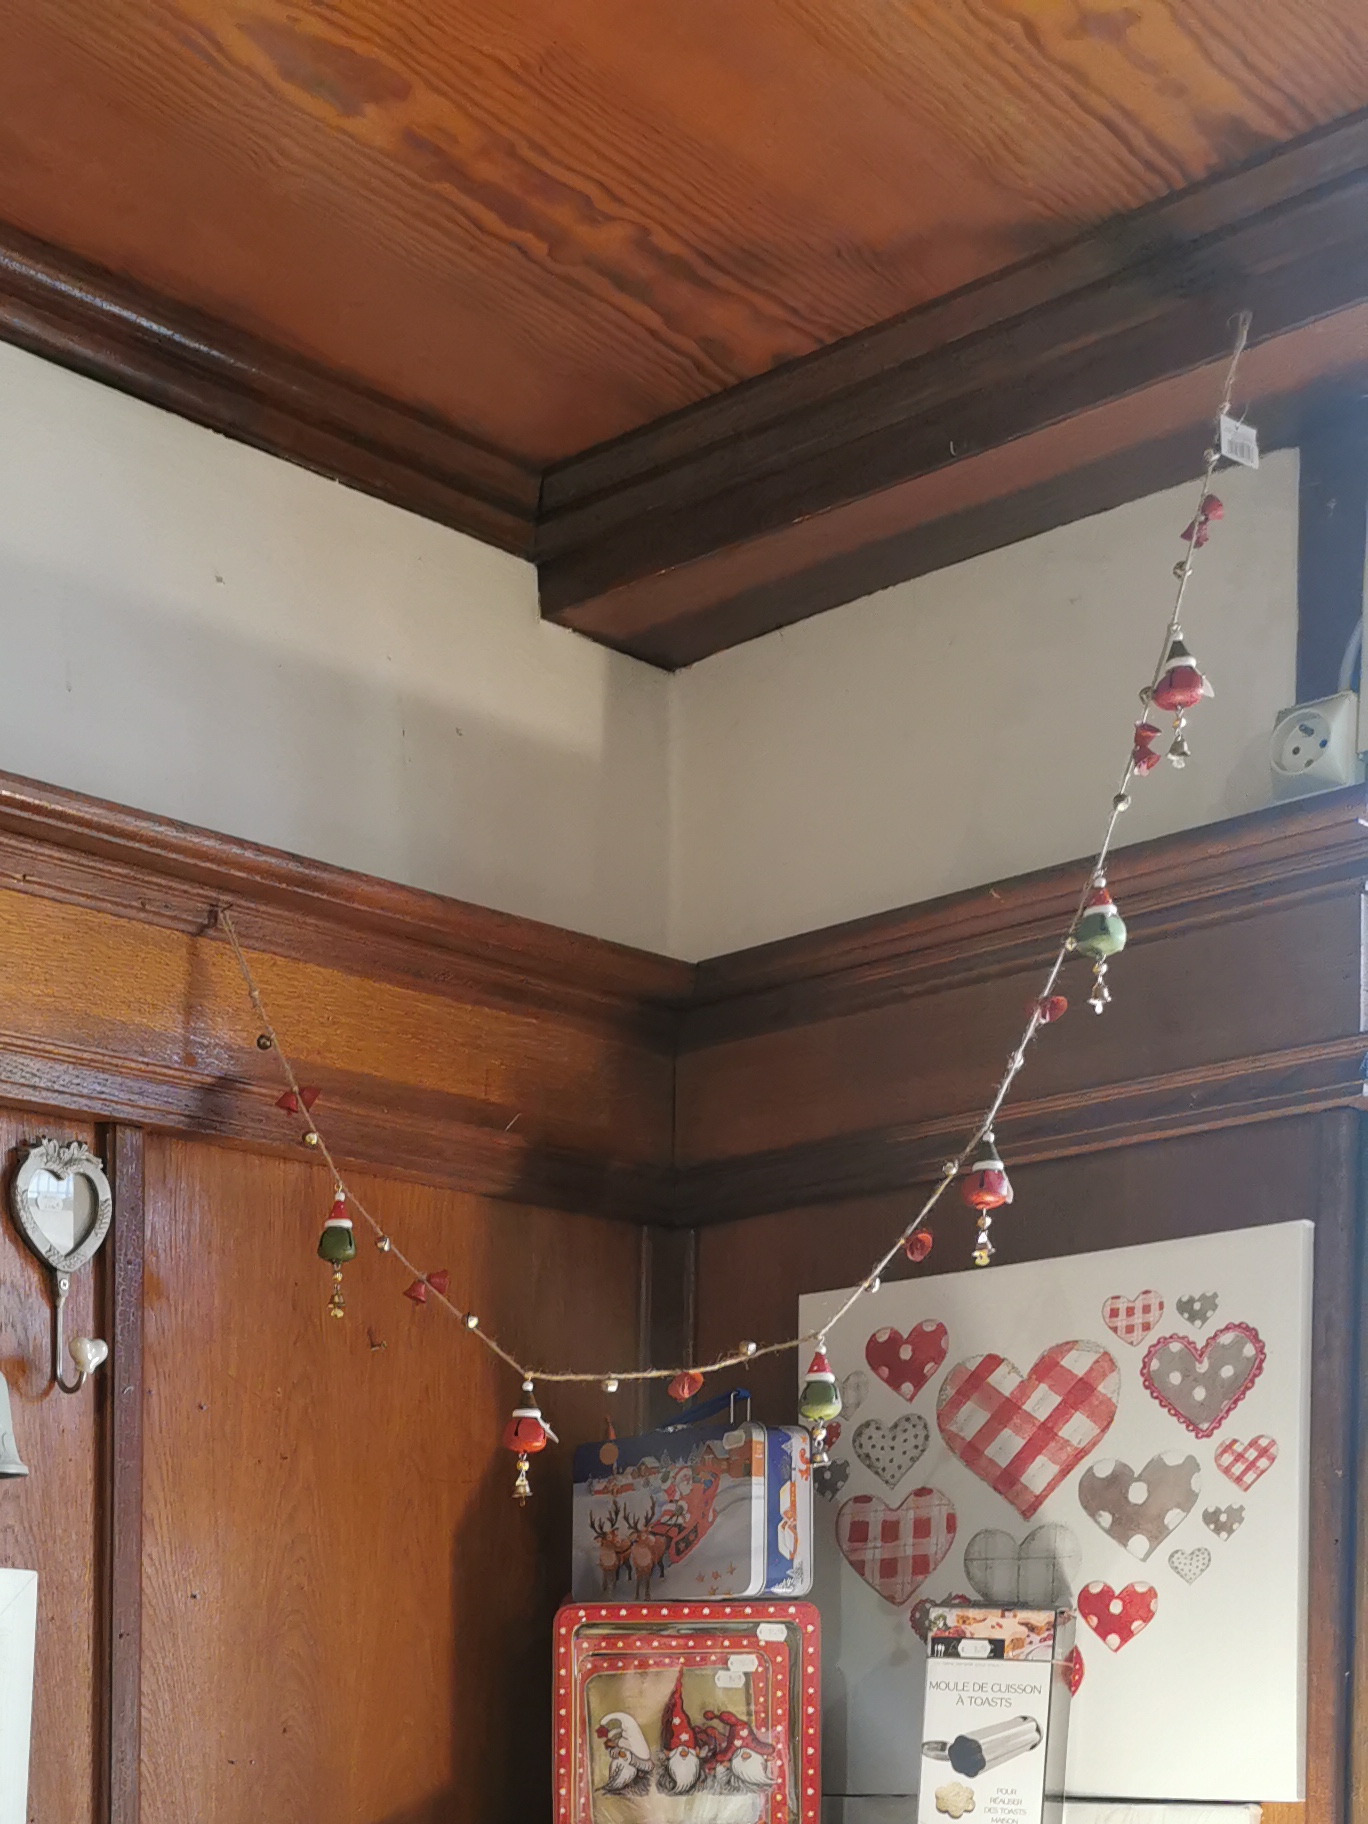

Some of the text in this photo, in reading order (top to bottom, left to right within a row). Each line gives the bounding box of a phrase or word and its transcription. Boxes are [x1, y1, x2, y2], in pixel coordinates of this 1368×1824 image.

[929, 1681, 1042, 1695] MOULE DE CUISSON
[956, 1694, 1012, 1708] À TOASTS
